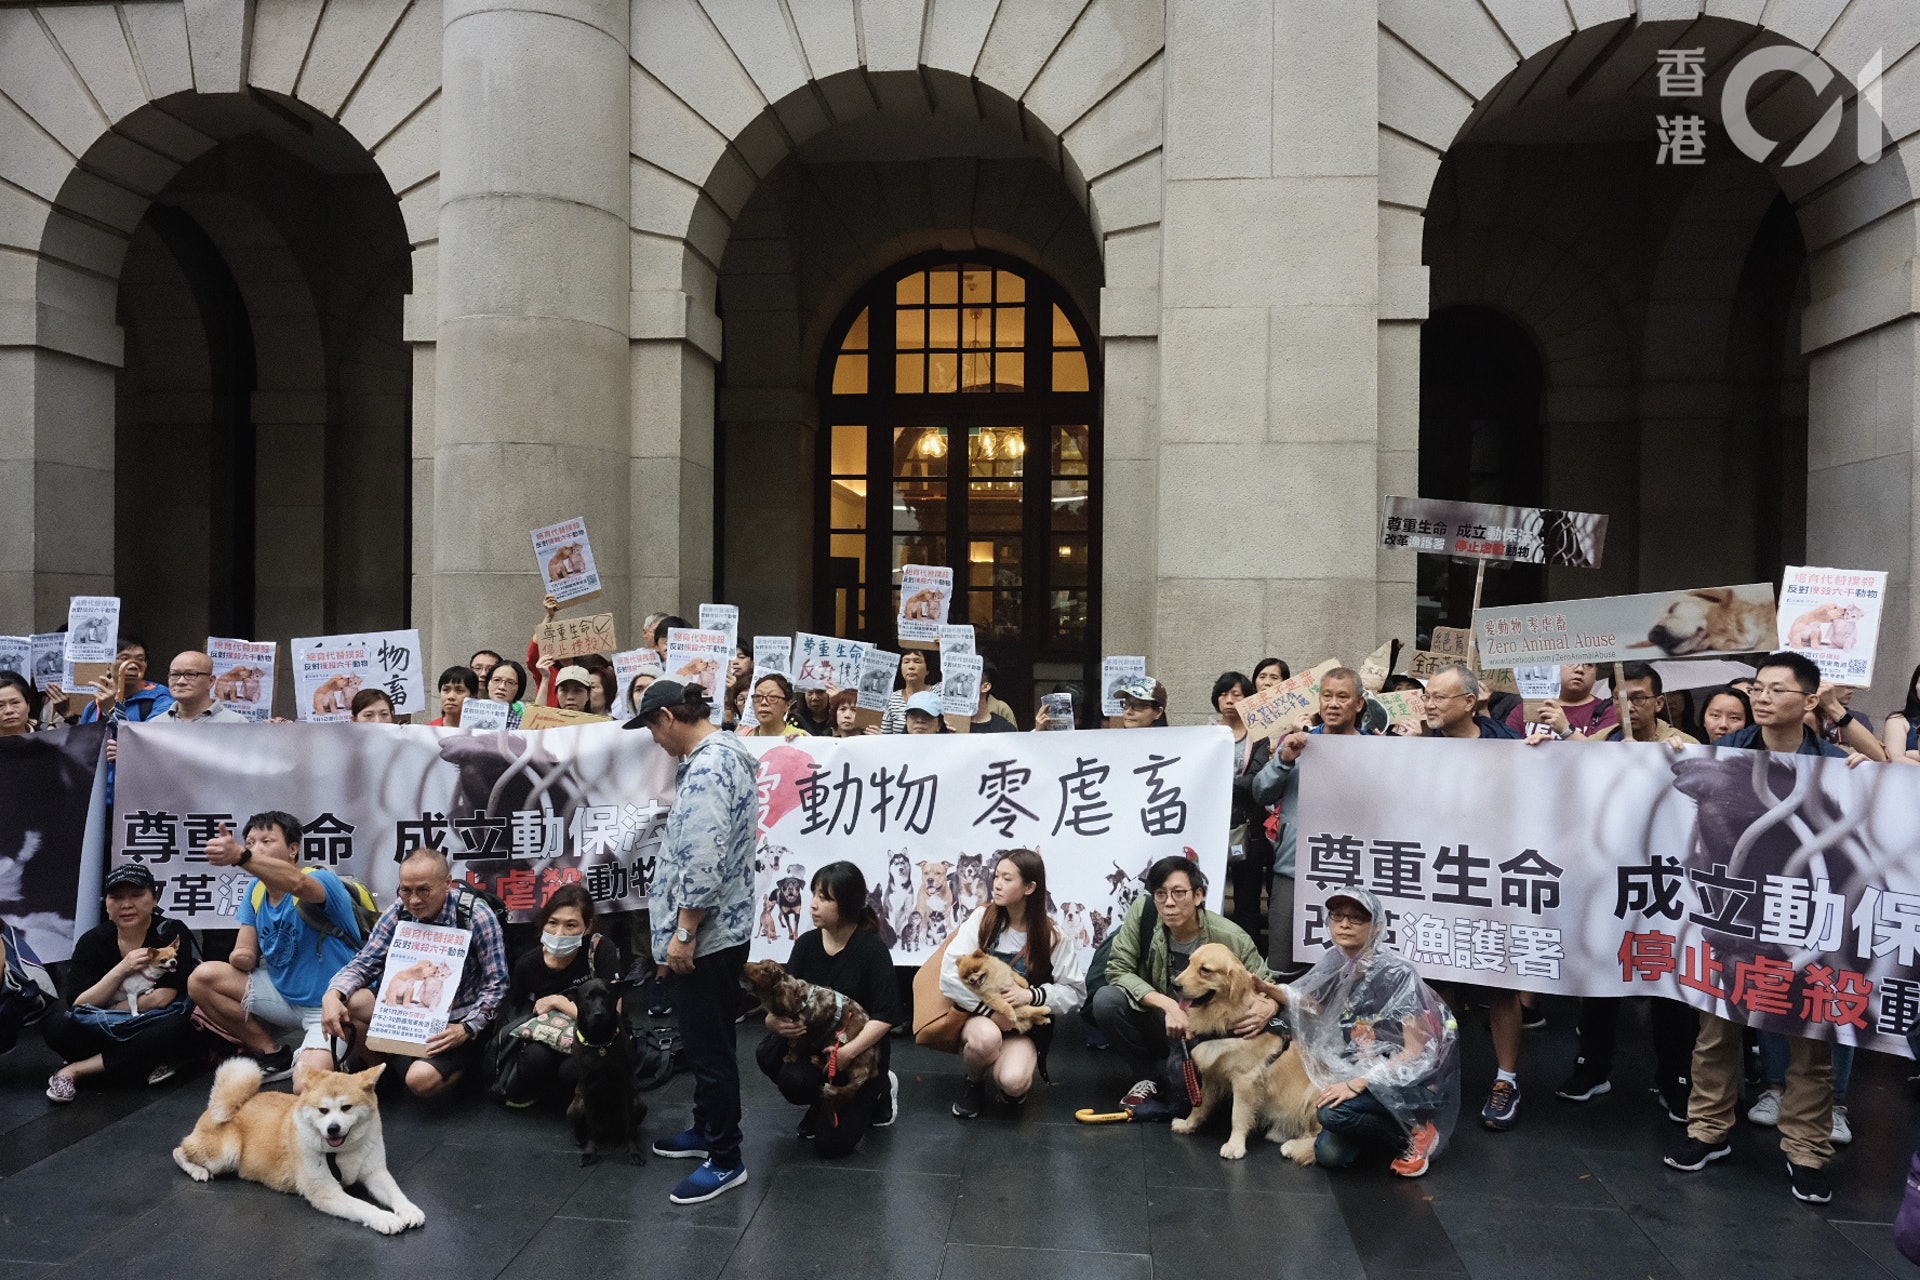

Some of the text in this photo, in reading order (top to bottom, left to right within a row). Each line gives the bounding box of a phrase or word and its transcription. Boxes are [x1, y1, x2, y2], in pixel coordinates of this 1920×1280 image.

[1386, 516, 1535, 546] 尊重生命 成立動保法
[541, 620, 593, 643] 尊重生命
[1485, 614, 1567, 636] 愛動物 零虐畜
[377, 639, 411, 672] 物
[803, 637, 864, 661] 尊重生命
[1488, 632, 1616, 654] Zero Animal Abuse
[383, 674, 408, 706] 畜
[972, 753, 1189, 839] 零虐畜
[121, 810, 357, 866] 尊重命
[1306, 832, 1564, 915] 尊重生命
[392, 938, 466, 958] 反對撲殺六千動物
